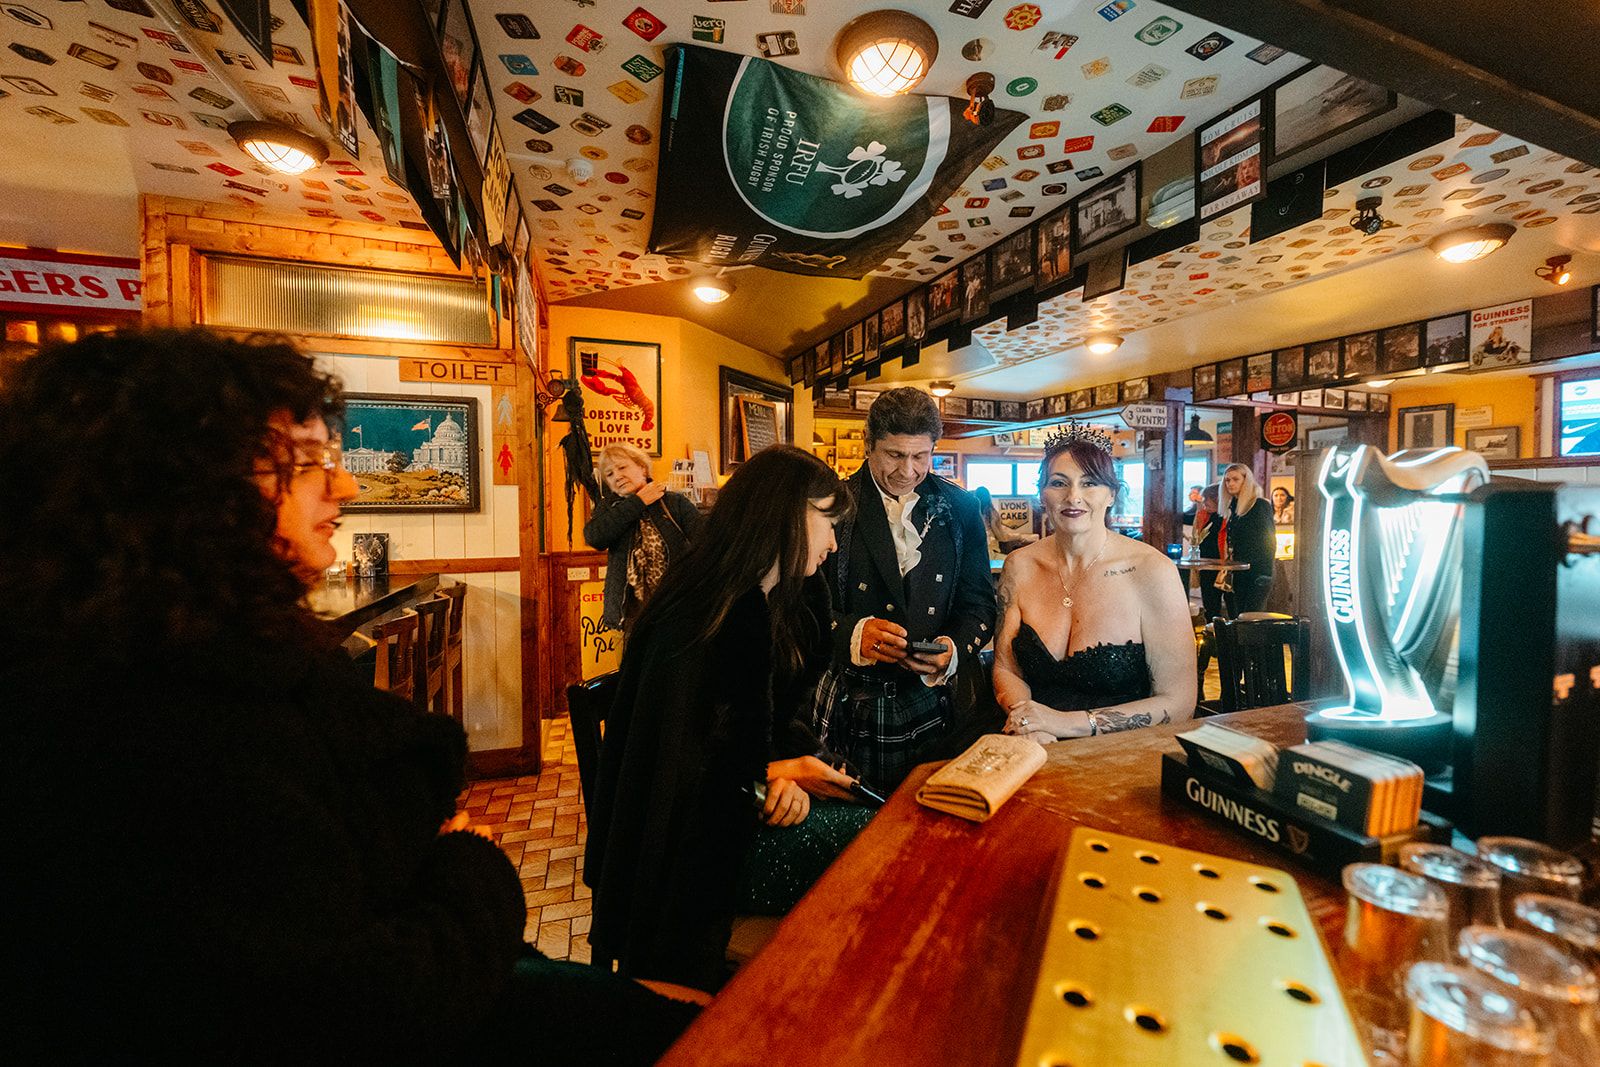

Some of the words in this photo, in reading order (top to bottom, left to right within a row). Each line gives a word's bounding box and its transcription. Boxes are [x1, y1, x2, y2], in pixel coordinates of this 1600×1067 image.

[694, 16, 725, 30] berg
[767, 107, 779, 123] OF
[777, 110, 797, 149] PROUD
[1203, 130, 1221, 143] TOM
[1224, 108, 1259, 133] CRUISE
[758, 126, 773, 156] IRISH
[786, 138, 821, 186] IRFU
[1203, 163, 1228, 179] NICOLE
[1230, 146, 1259, 166] KIDMAN
[748, 160, 765, 187] RUGBY
[761, 153, 784, 193] SPONSOR
[1236, 185, 1260, 202] AWAY
[1473, 305, 1530, 323] GUINNESS
[1490, 314, 1529, 327] STRENGTH
[413, 361, 502, 381] TOILET
[583, 408, 640, 421] LOBSTERS
[1128, 410, 1134, 421] 3
[1136, 415, 1167, 425] VENTRY
[600, 421, 630, 434] LOVE
[1000, 502, 1028, 511] LYONS
[1000, 512, 1028, 520] CAKES
[1330, 528, 1355, 624] GUINNESS
[1292, 761, 1353, 794] DINGLE
[1186, 777, 1280, 843] GUINNESS
